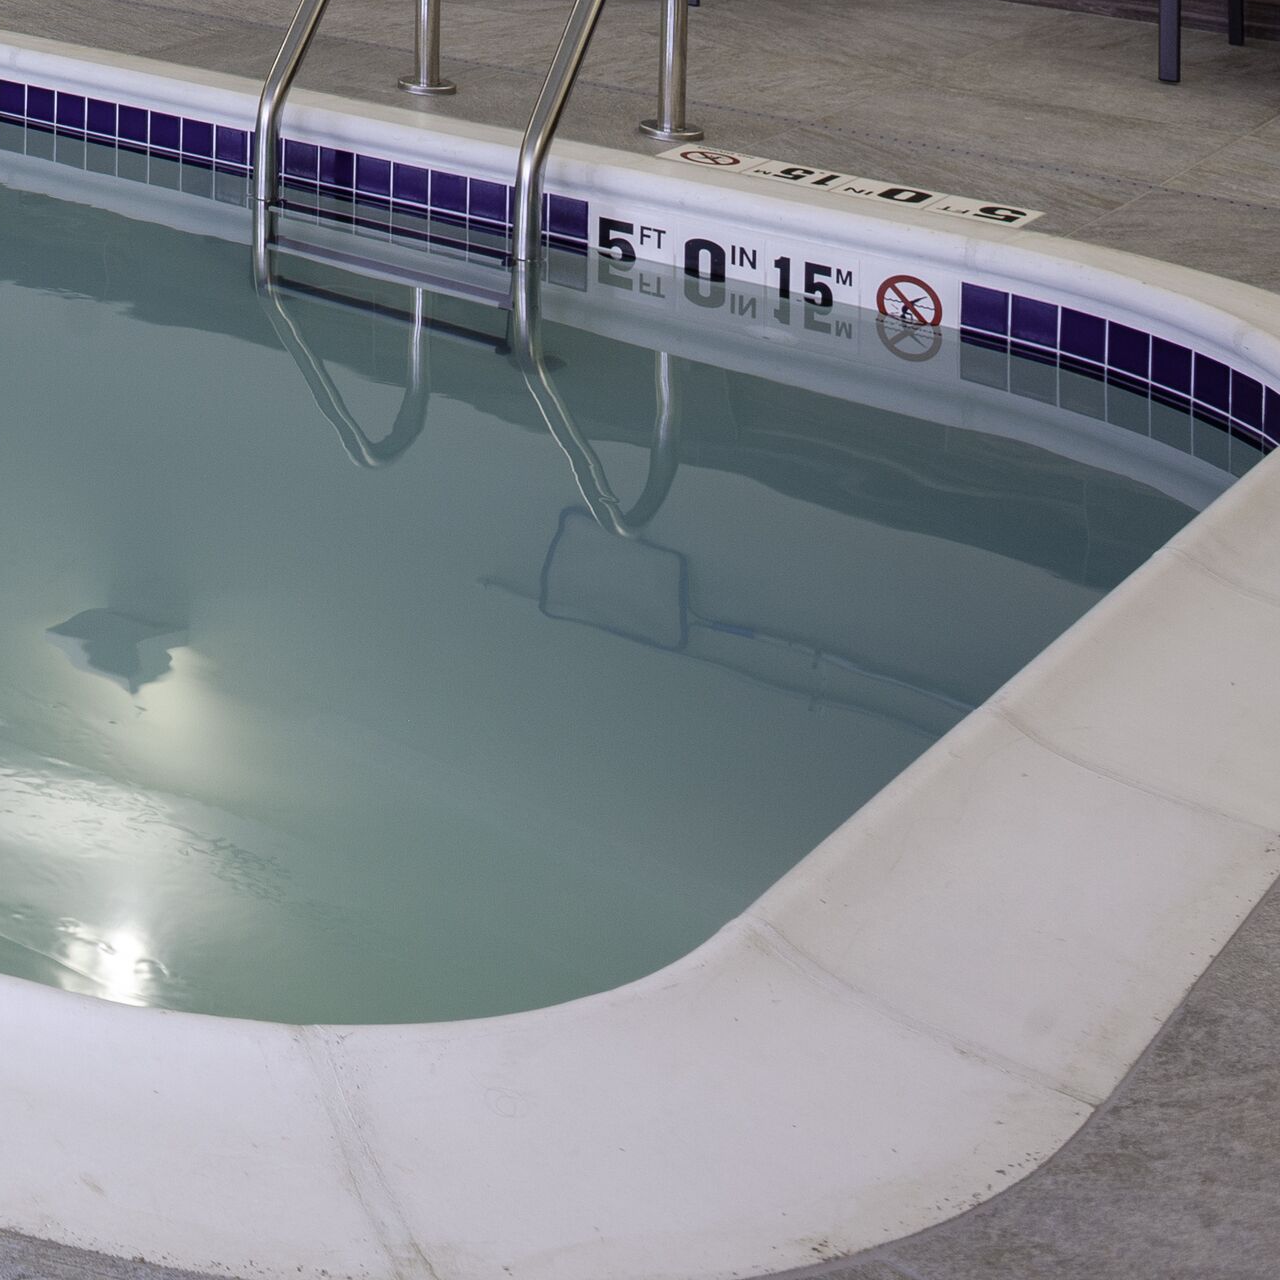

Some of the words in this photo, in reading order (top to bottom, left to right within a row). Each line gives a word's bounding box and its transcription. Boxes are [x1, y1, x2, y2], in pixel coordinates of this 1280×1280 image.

[844, 187, 873, 195] IN
[877, 188, 933, 203] 0
[937, 206, 969, 214] FT
[973, 206, 1026, 223] 5
[598, 216, 636, 262] 5
[640, 225, 666, 249] FT
[685, 238, 726, 282] 0
[731, 245, 756, 270] IN
[836, 268, 852, 286] M
